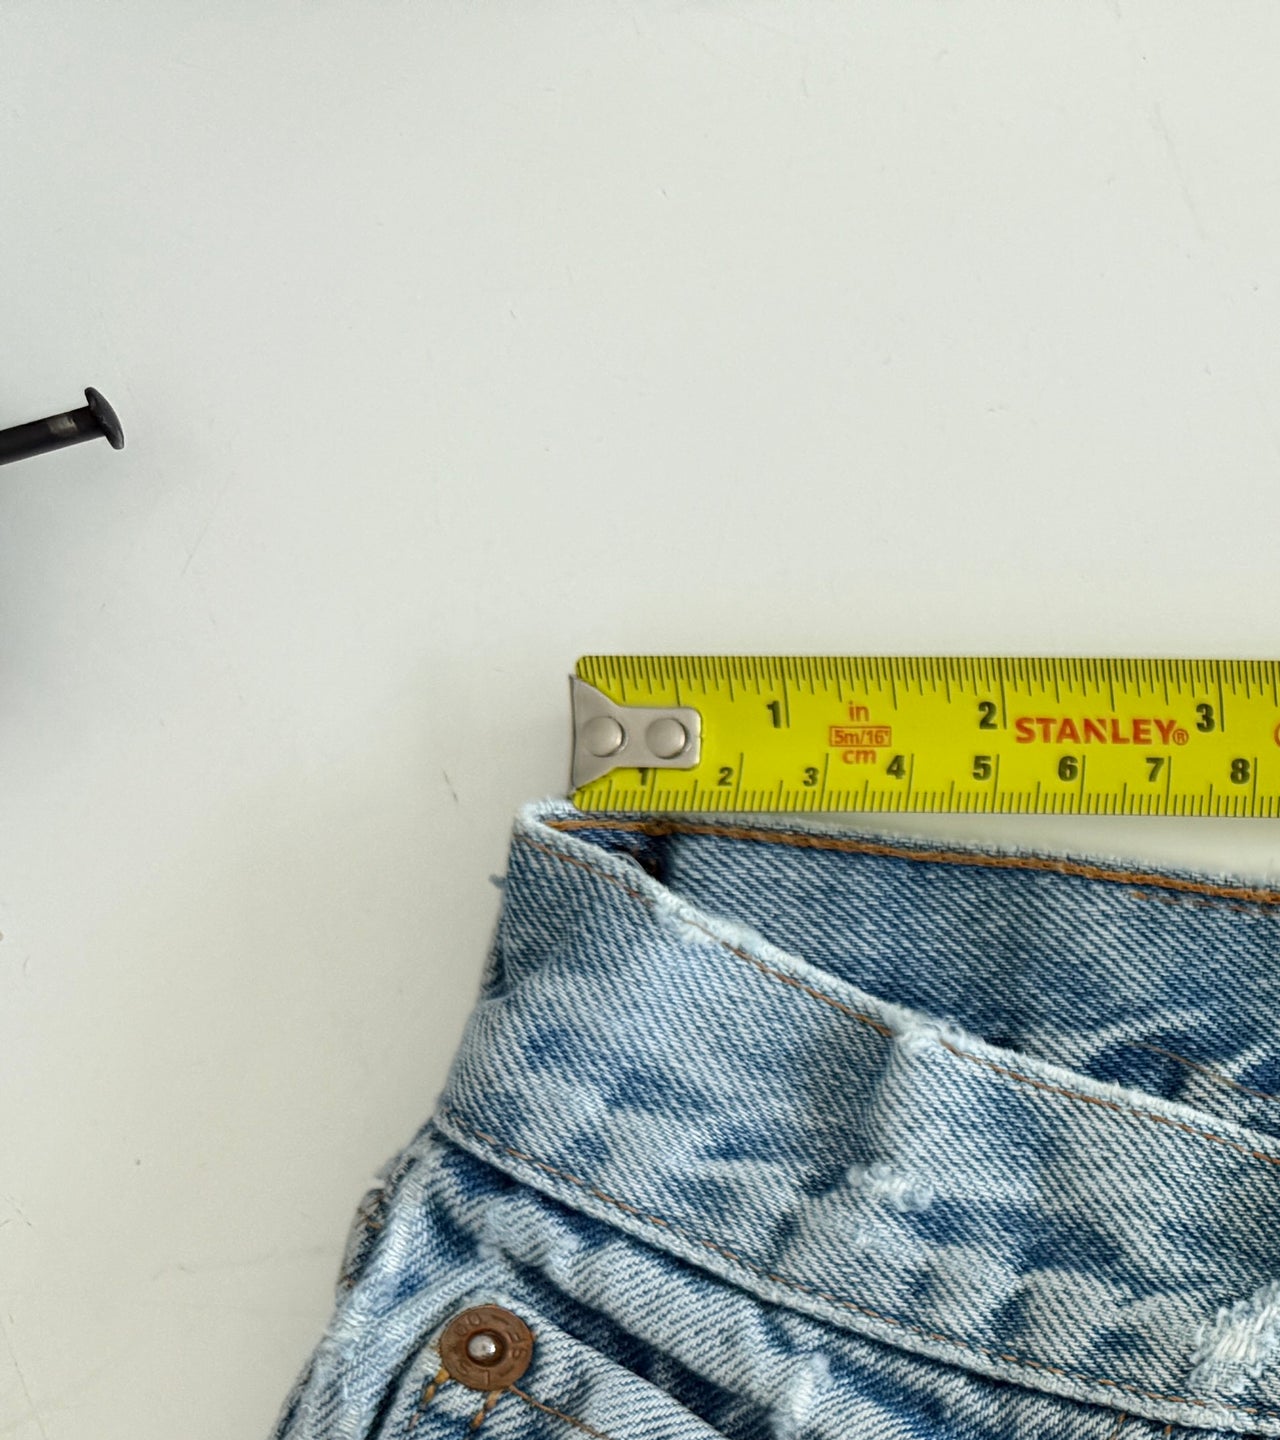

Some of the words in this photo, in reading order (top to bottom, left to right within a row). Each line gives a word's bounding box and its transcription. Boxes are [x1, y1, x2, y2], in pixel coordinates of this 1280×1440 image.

[767, 701, 781, 728] 1
[978, 701, 998, 730] 2
[1196, 703, 1215, 733] 3
[848, 700, 870, 721] in
[842, 750, 876, 765] cm
[637, 767, 649, 787] 1
[718, 767, 733, 786] 2
[803, 767, 819, 787] 3
[886, 755, 906, 780] 4
[972, 755, 992, 781] 5
[1058, 756, 1078, 782] 6
[1146, 757, 1164, 782] 7
[1230, 758, 1250, 784] 8
